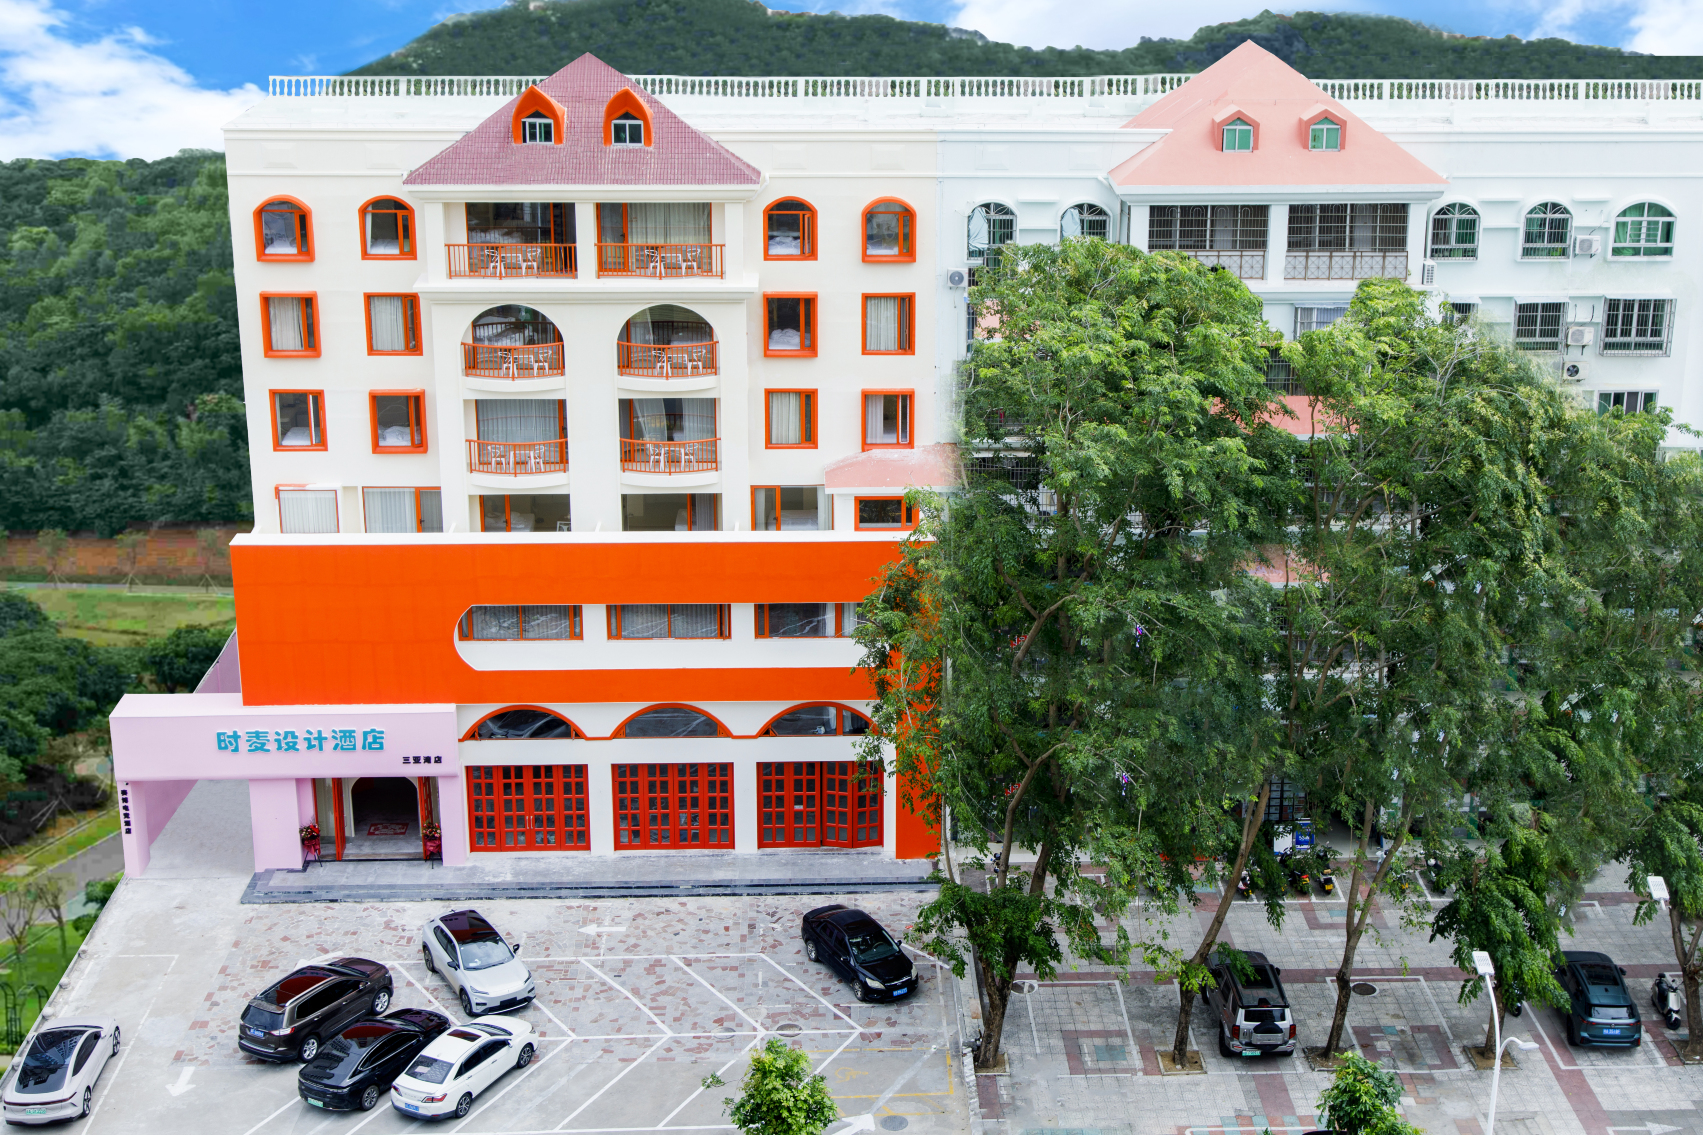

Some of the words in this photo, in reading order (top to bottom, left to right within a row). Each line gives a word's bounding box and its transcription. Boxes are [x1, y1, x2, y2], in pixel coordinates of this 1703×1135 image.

[216, 728, 385, 753] 时麦设计酒店
[402, 755, 443, 765] 三亚湾店
